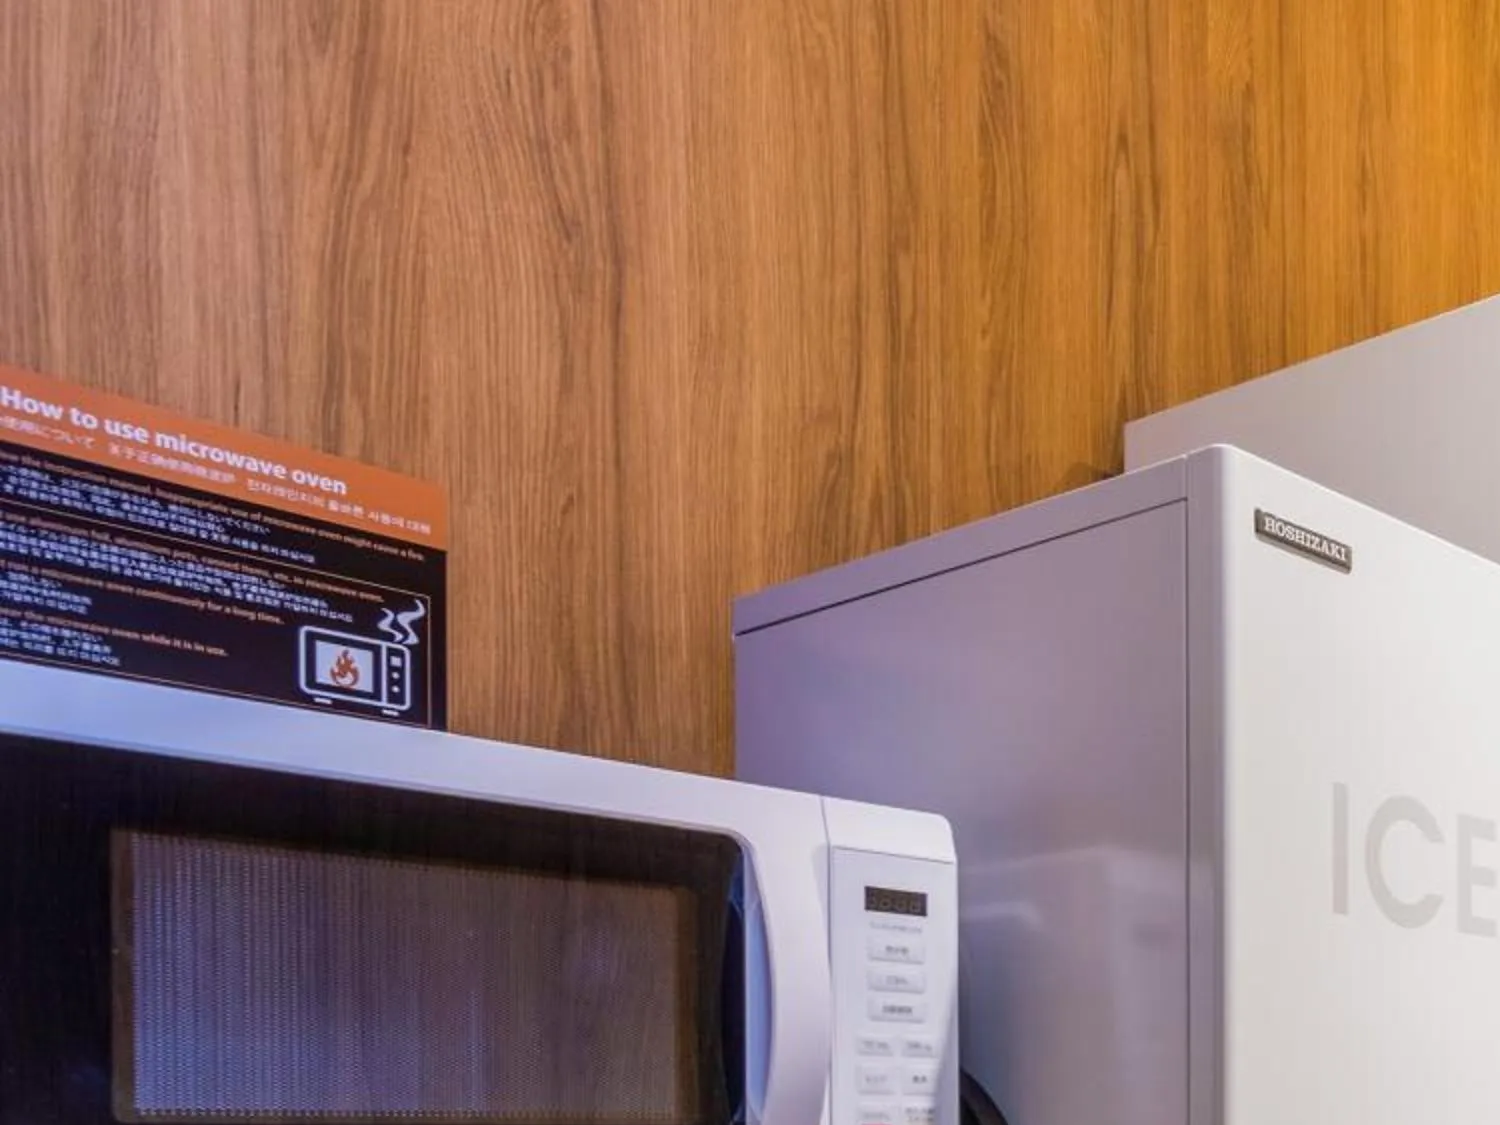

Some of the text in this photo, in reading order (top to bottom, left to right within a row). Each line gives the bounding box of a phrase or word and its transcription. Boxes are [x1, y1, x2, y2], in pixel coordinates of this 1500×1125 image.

[2, 385, 62, 420] How
[69, 404, 98, 430] to
[104, 418, 150, 443] use
[155, 430, 287, 480] microwave
[292, 468, 347, 496] oven
[1264, 517, 1347, 561] HOSHIZAKI
[1332, 782, 1497, 938] ICE
